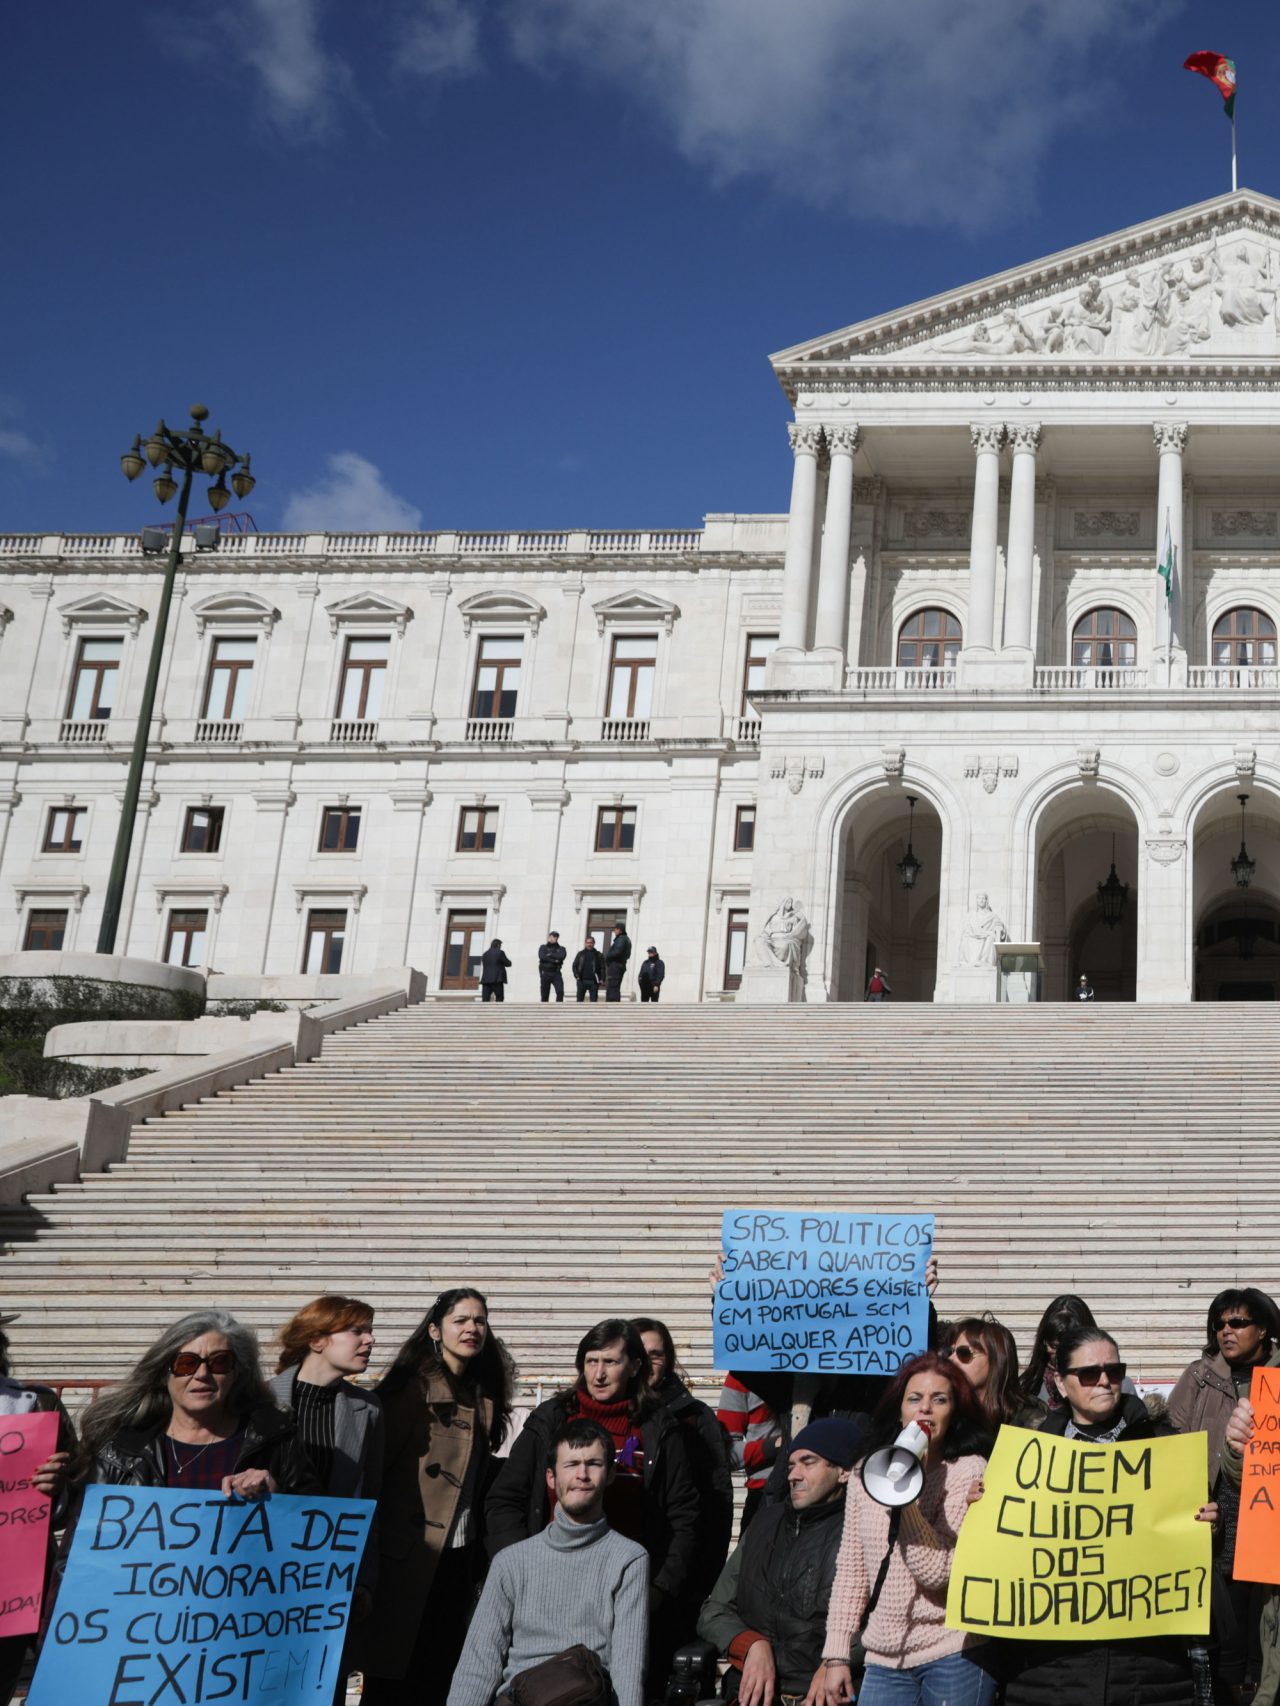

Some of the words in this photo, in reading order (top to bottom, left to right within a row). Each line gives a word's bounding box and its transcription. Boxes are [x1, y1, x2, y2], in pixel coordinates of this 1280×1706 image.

[730, 1215, 789, 1242] SRS.
[800, 1218, 932, 1247] POLITICOS
[723, 1249, 808, 1273] SABEM
[818, 1250, 916, 1273] QUANTOS
[719, 1307, 752, 1326] EM
[758, 1302, 858, 1325] PORTUGAL
[865, 1301, 910, 1318] SEM
[724, 1330, 837, 1353] QUALQUER
[845, 1322, 913, 1349] APOIO
[770, 1352, 808, 1371] DO
[1015, 1437, 1152, 1494] QUEM
[1249, 1486, 1274, 1511] A
[89, 1494, 274, 1556] BASTA
[290, 1509, 367, 1553] DE
[996, 1495, 1135, 1541] CUIDA
[1032, 1544, 1105, 1579] DOS
[113, 1561, 356, 1600] IGNORAREM
[54, 1608, 110, 1645] OS
